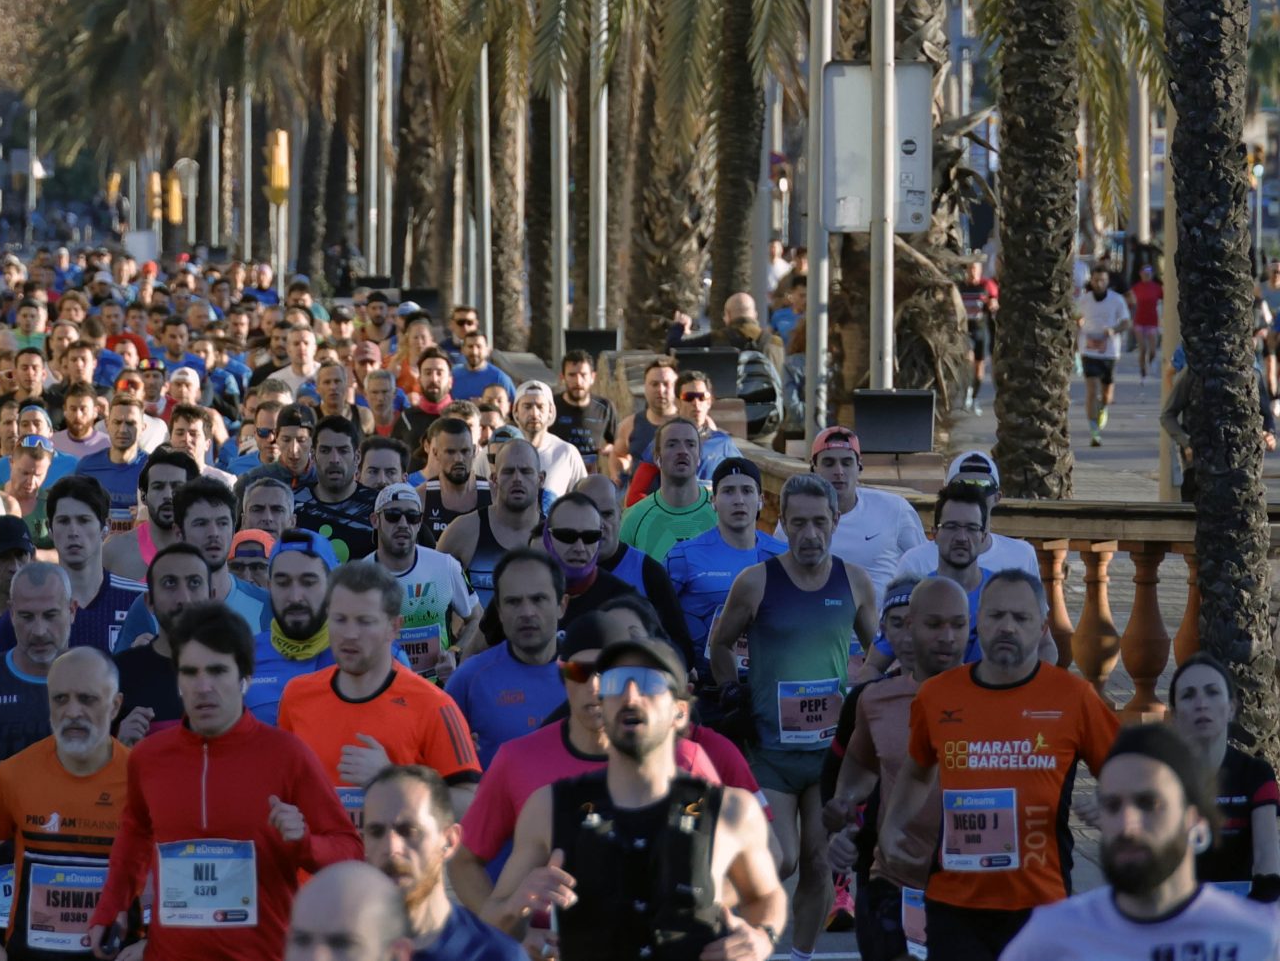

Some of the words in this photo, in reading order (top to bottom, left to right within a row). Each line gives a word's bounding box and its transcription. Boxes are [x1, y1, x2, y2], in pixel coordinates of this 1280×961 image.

[800, 698, 828, 713] PEPE
[970, 739, 1032, 754] MARATÓ
[969, 755, 1056, 769] BARCELONA
[953, 813, 986, 830] DIEGO
[992, 812, 998, 830] J
[1024, 805, 1050, 869] 2011
[196, 844, 234, 854] eDreams
[65, 873, 103, 883] eDreams
[193, 863, 219, 881] NIL
[193, 885, 218, 896] 4370
